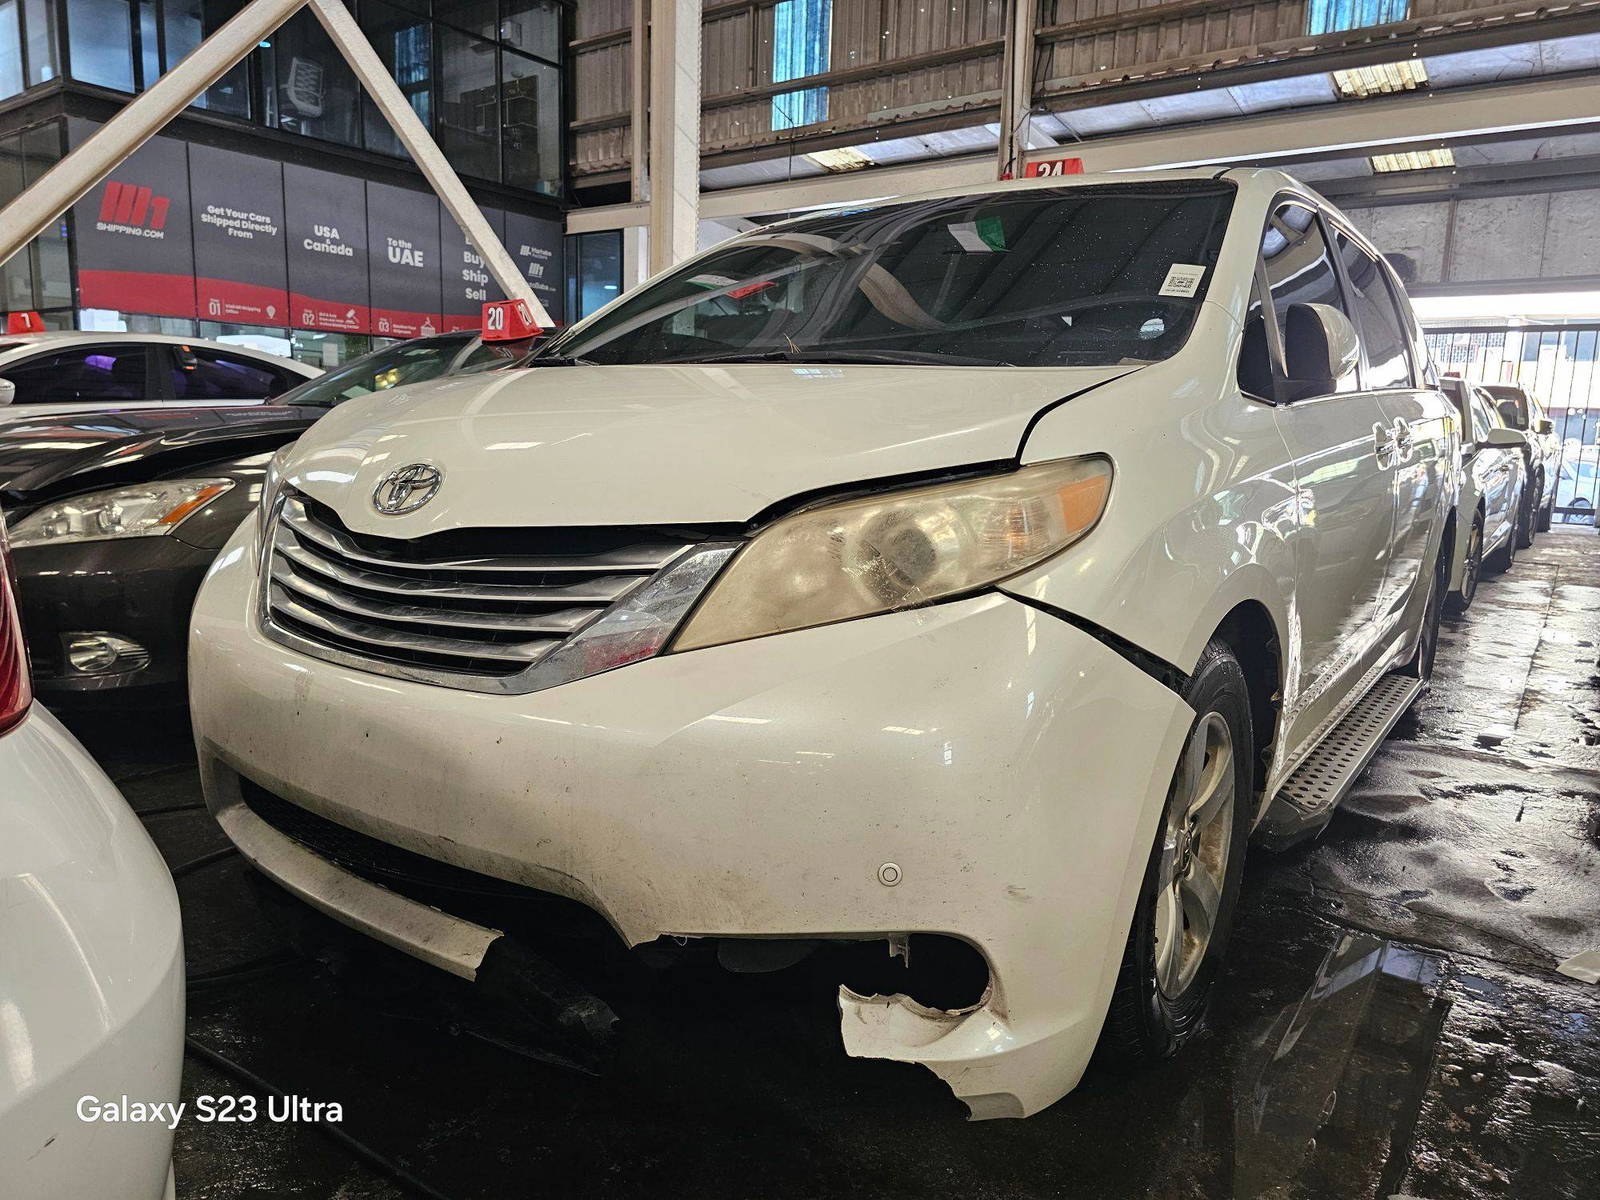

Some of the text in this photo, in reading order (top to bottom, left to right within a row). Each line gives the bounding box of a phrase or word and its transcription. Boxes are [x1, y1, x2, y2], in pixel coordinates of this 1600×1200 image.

[1037, 161, 1064, 178] 24
[207, 205, 271, 224] Get Your Cars
[200, 213, 278, 236] Shipped Directly
[313, 225, 340, 240] USA
[228, 228, 253, 239] From
[303, 239, 354, 257] Canada
[386, 237, 412, 249] To the
[387, 246, 424, 268] UAE
[463, 251, 486, 269] Buy
[462, 269, 489, 287] Ship
[465, 288, 487, 301] Sell
[208, 301, 221, 316] 01
[302, 312, 316, 326] 02
[487, 306, 504, 330] 20
